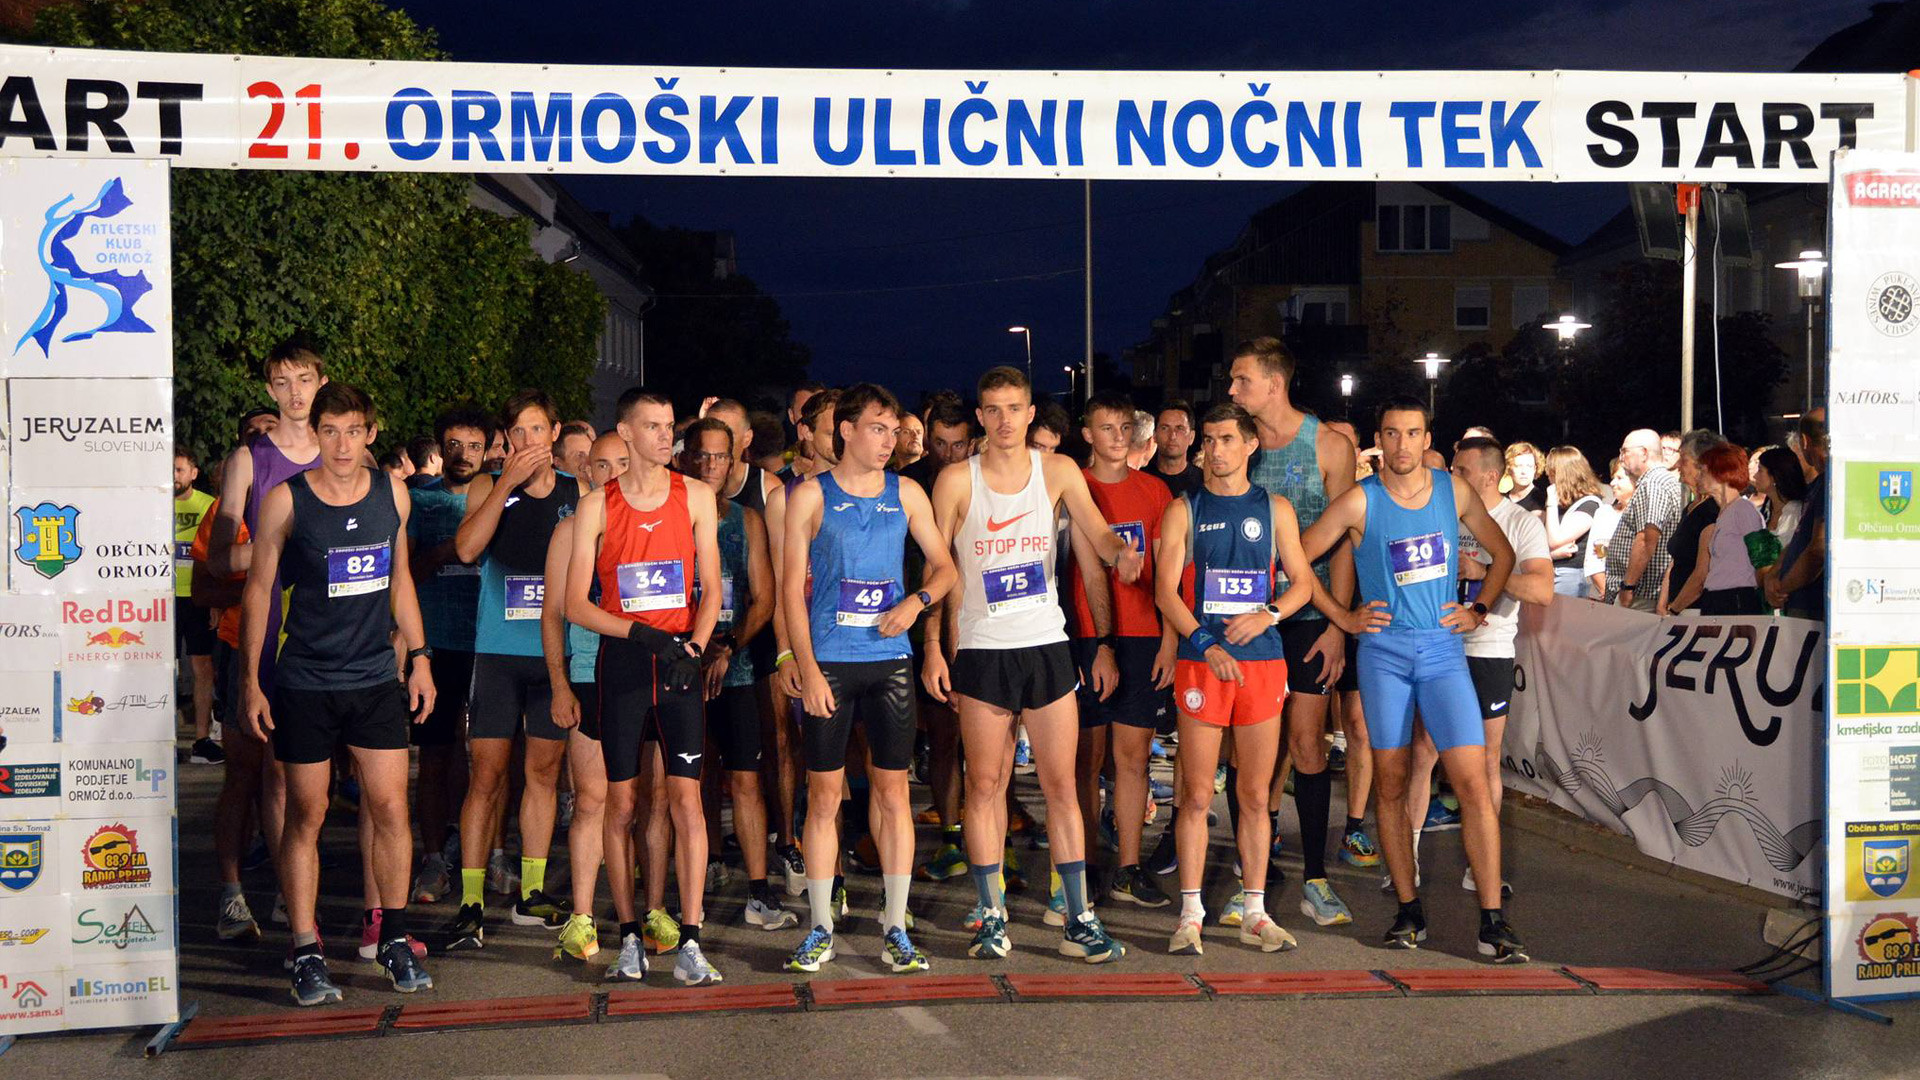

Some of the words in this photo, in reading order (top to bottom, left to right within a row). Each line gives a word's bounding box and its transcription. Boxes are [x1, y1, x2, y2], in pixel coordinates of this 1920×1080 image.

[0, 76, 203, 155] ART
[247, 81, 360, 160] 21.
[385, 77, 778, 164] ORMOŠKI
[813, 81, 1084, 166] ULIČNI
[1116, 83, 1362, 168] NOČNI
[1389, 100, 1543, 168] TEK
[1585, 100, 1874, 169] START
[91, 223, 157, 235] ATLETSKI
[106, 238, 142, 249] KLUB
[96, 251, 152, 263] ORMOŽ
[20, 417, 165, 442] JERUZALEM
[84, 440, 165, 452] SLOVENIJA
[96, 541, 170, 557] OBČINA
[975, 538, 1017, 556] STOP
[1021, 536, 1049, 552] PRE
[1405, 542, 1433, 563] 20
[98, 561, 170, 578] ORMOŽ
[347, 555, 376, 574] 82
[635, 569, 667, 589] 34
[1000, 572, 1029, 592] 75
[1217, 577, 1253, 595] 133
[523, 585, 545, 601] 55
[855, 588, 884, 607] 49
[62, 600, 113, 623] Red
[118, 598, 167, 622] Bull
[68, 653, 119, 662] ENERGY
[124, 651, 163, 660] DRINK
[1628, 624, 1823, 746] JERU
[1837, 723, 1892, 738] kmetijska
[69, 759, 135, 771] KOMUNALNO
[76, 774, 128, 786] PODJETJE
[69, 788, 106, 801] ORMOŽ
[109, 790, 135, 800] d.o.o.
[1848, 823, 1877, 833] Občina
[1879, 822, 1900, 831] Sveti
[131, 852, 148, 866] FM
[1857, 963, 1893, 980] RADIO
[93, 977, 170, 996] SmonEL
[0, 1007, 63, 1020] www.sam.si
